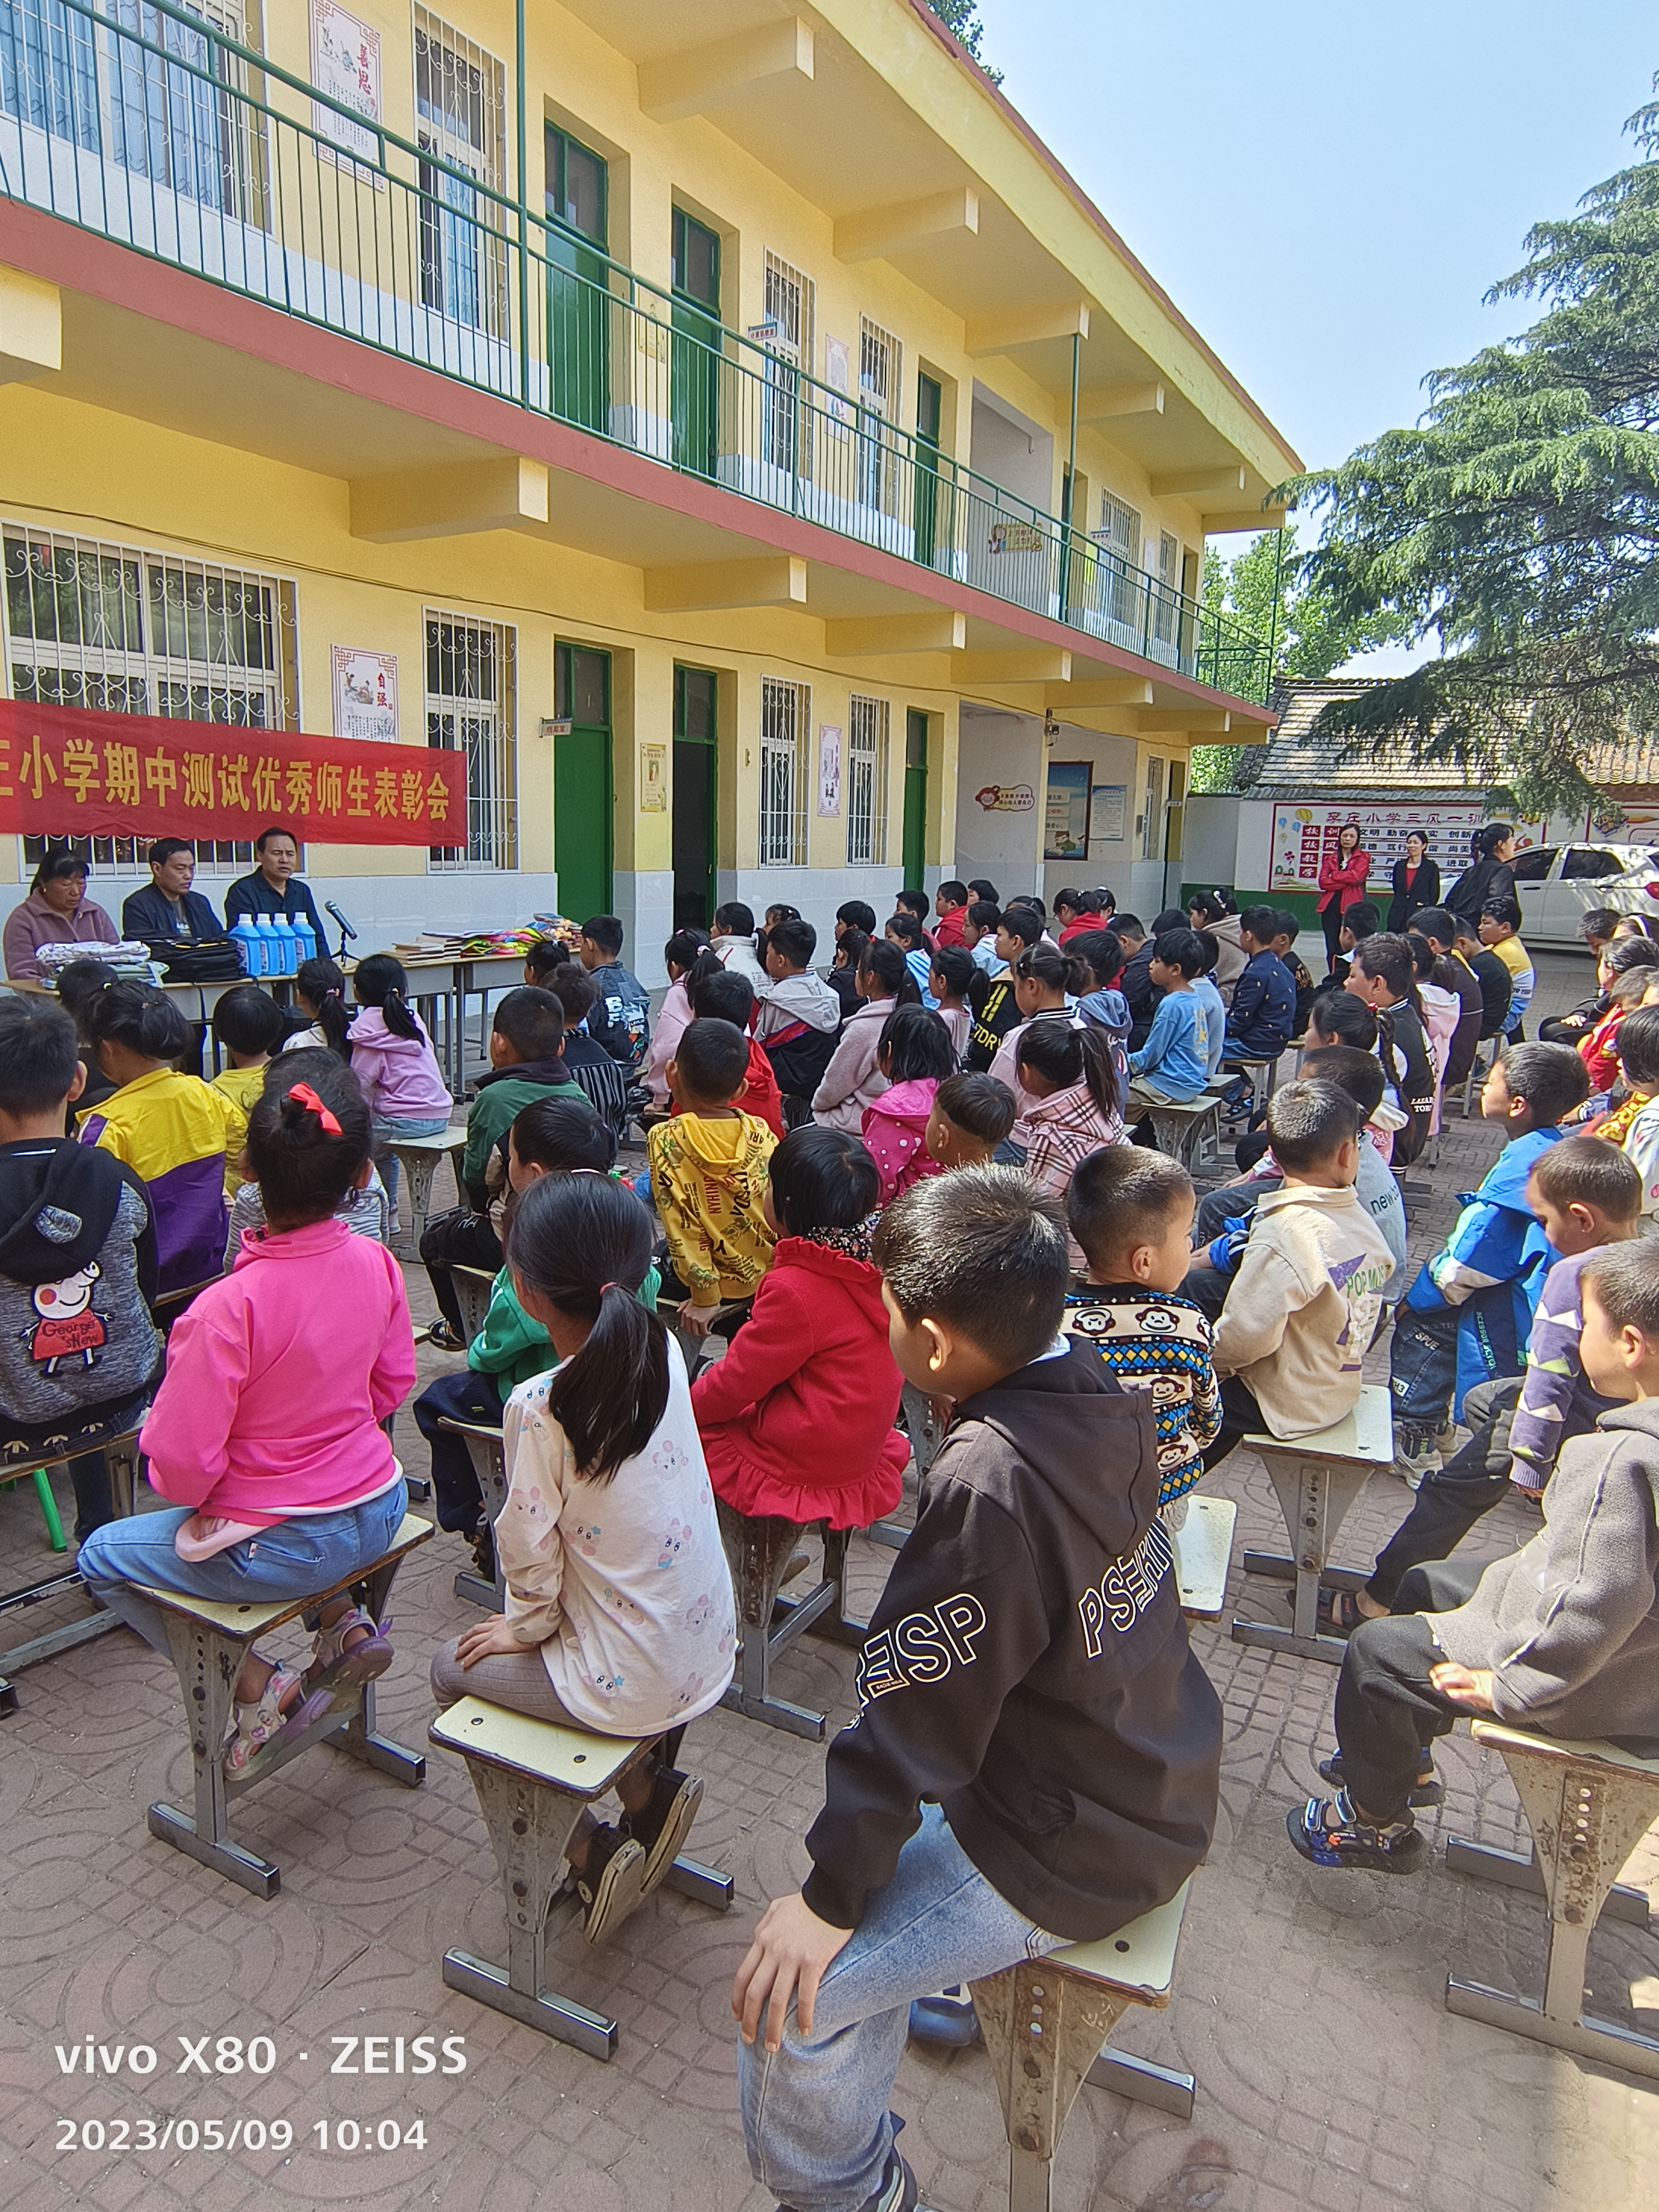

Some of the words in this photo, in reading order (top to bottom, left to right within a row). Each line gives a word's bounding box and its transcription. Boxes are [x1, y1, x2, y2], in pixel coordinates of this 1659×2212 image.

[1448, 831, 1472, 839] 创新
[1446, 858, 1468, 867] 进取
[42, 1321, 95, 1337] George
